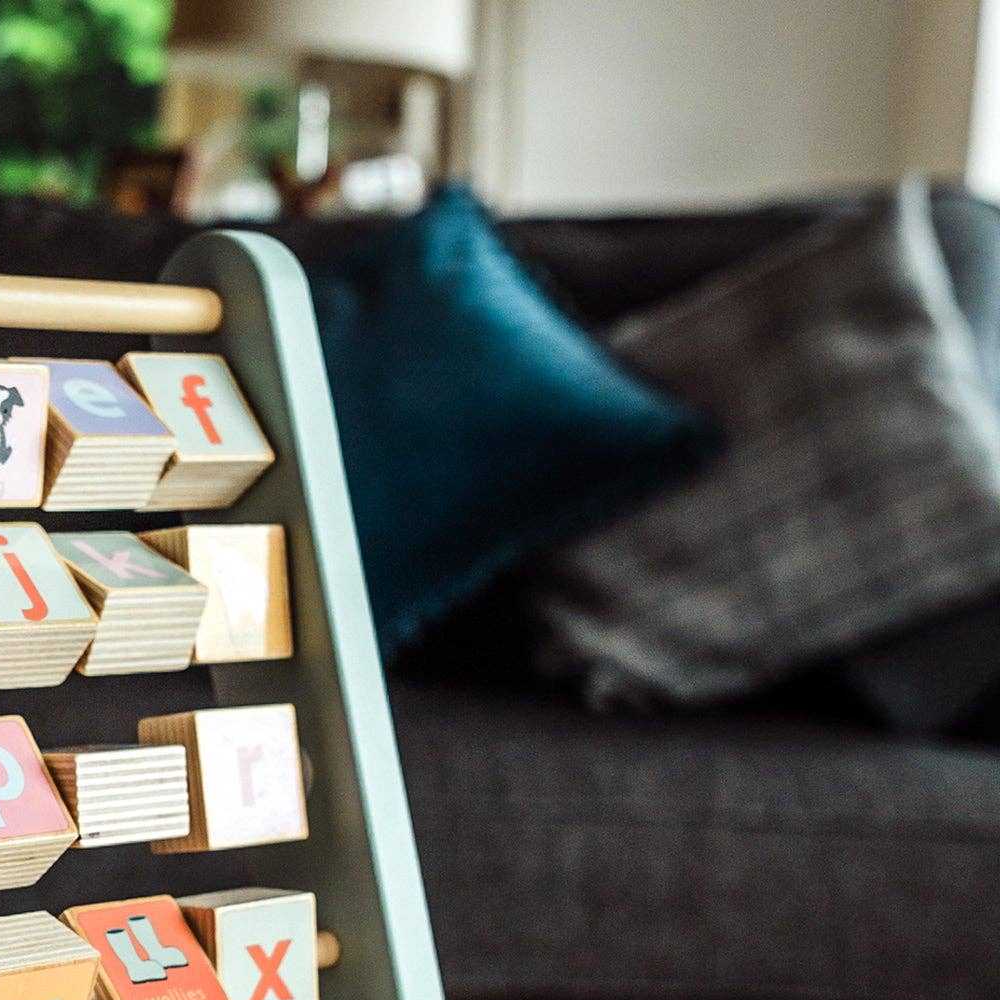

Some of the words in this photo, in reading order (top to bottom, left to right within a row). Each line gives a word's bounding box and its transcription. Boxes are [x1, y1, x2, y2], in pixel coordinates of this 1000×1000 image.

[62, 379, 127, 418] e
[179, 374, 223, 445] f
[72, 540, 168, 580] k
